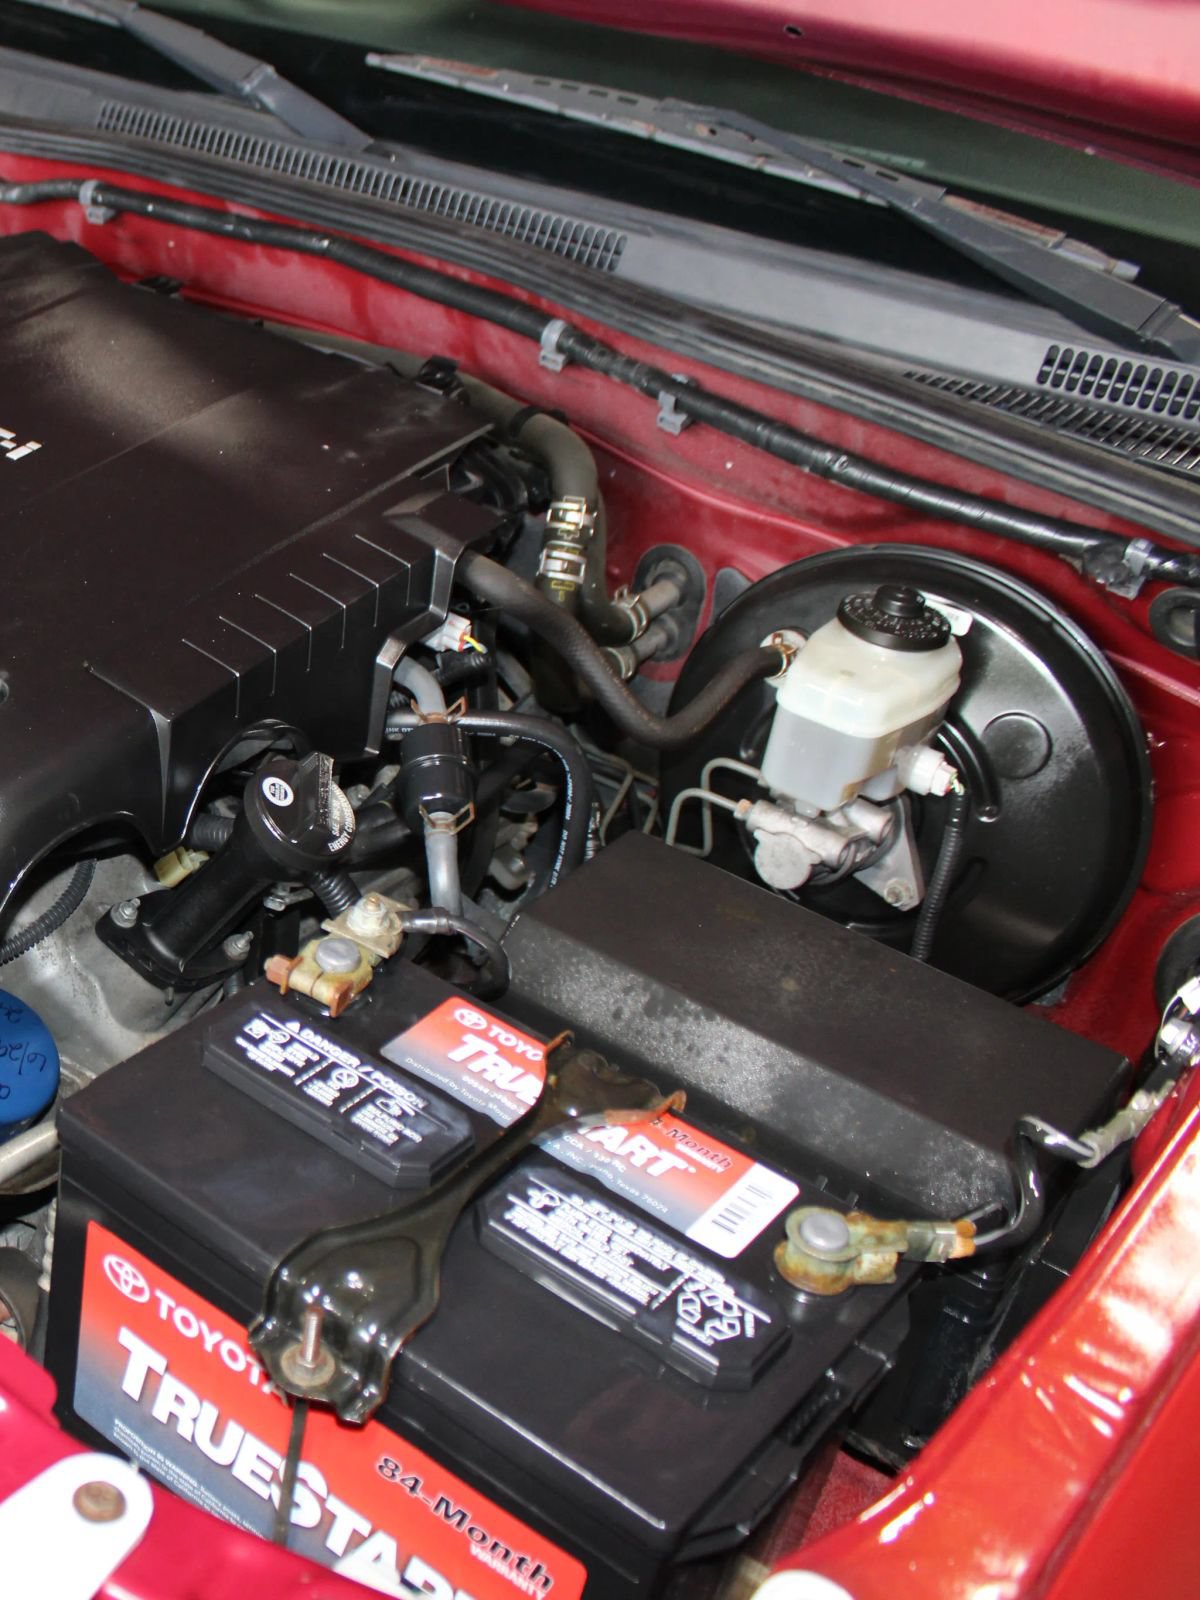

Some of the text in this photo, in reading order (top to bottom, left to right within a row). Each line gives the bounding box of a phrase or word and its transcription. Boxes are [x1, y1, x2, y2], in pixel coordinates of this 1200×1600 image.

[327, 830, 352, 852] ENERGY
[297, 1027, 363, 1068] DANGER
[368, 1070, 429, 1108] POISON
[488, 1024, 544, 1062] TOYO
[650, 1116, 732, 1170] 4-Month
[155, 1289, 273, 1395] TOYOT
[117, 1325, 474, 1599] TRUESTA
[376, 1454, 554, 1592] 84-Month
[469, 1542, 547, 1600] WARRANTY
